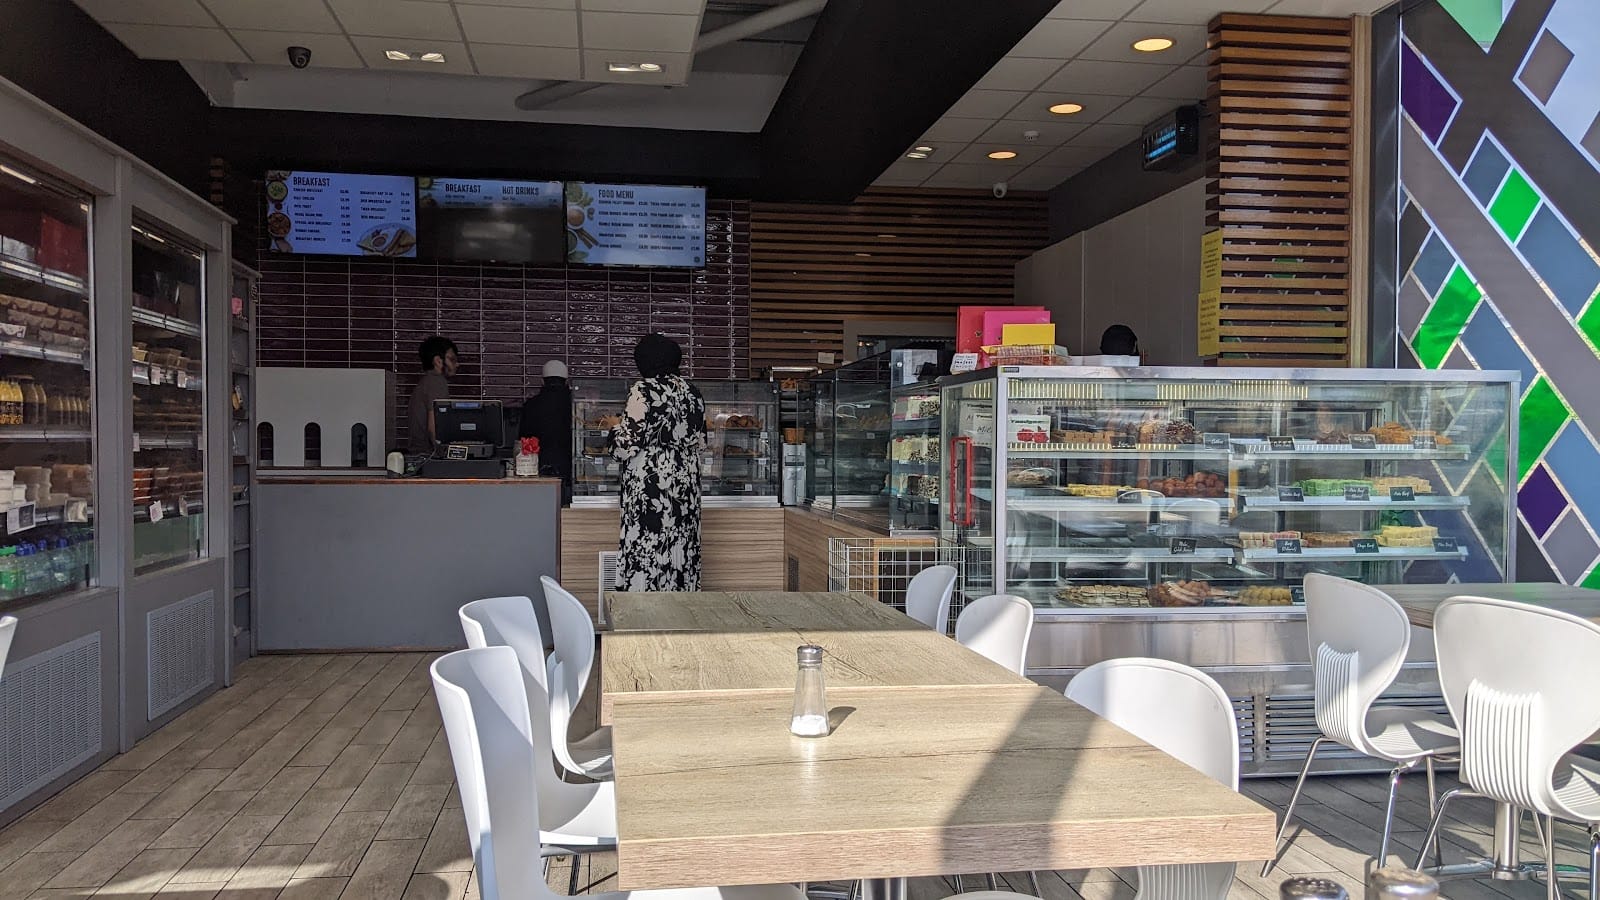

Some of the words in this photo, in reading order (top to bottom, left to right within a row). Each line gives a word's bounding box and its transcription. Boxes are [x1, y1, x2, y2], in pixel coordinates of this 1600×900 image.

[293, 176, 330, 187] BREAKFAST
[445, 183, 481, 193] BREAKFAST
[502, 185, 514, 195] HOT
[515, 186, 539, 196] DRINKS
[598, 189, 614, 198] FOOD
[615, 190, 634, 199] MENU
